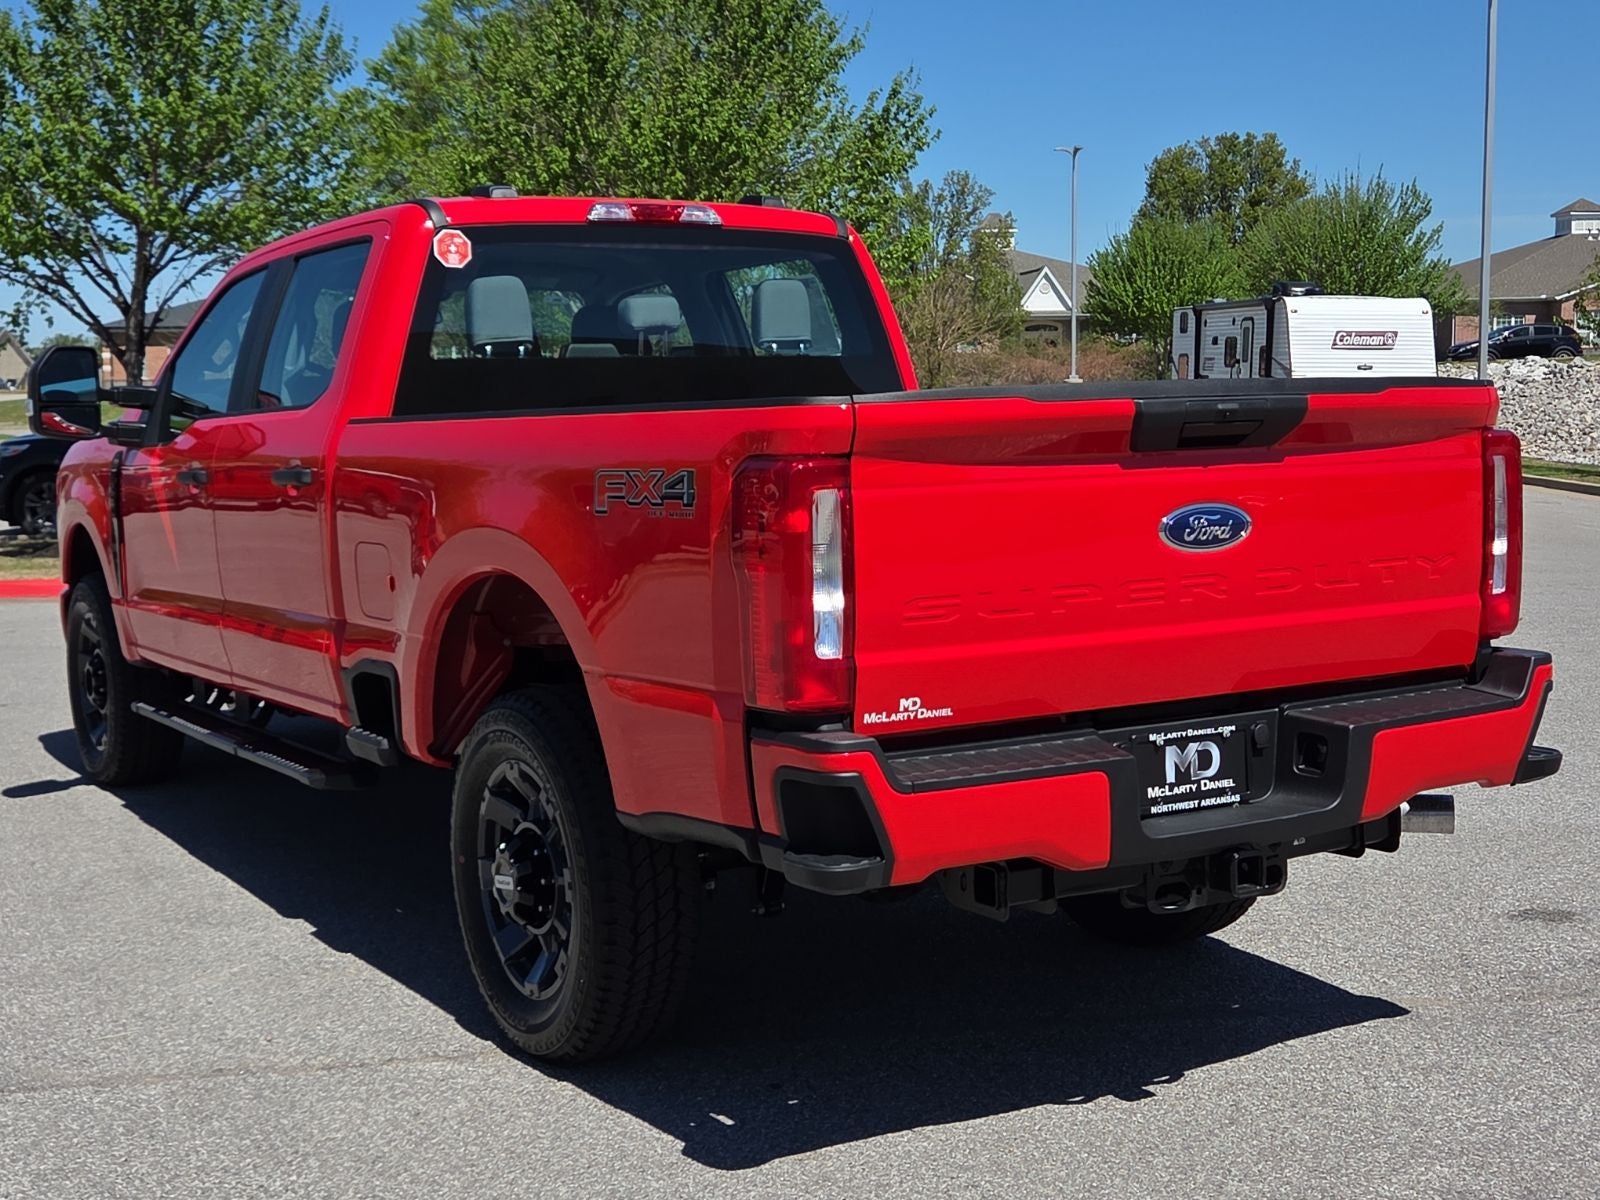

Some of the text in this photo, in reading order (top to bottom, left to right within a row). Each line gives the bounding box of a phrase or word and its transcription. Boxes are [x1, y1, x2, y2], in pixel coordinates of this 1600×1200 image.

[1336, 332, 1384, 345] Coleman
[594, 468, 697, 515] FX4
[1184, 514, 1233, 542] Ford
[901, 552, 1455, 626] SUPER DUTY
[899, 697, 921, 711] MD
[917, 708, 953, 719] DANIEL
[1165, 740, 1221, 784] MD
[1200, 778, 1236, 791] DANIEL
[1150, 794, 1240, 814] NORTHWEST ARKANSAS
